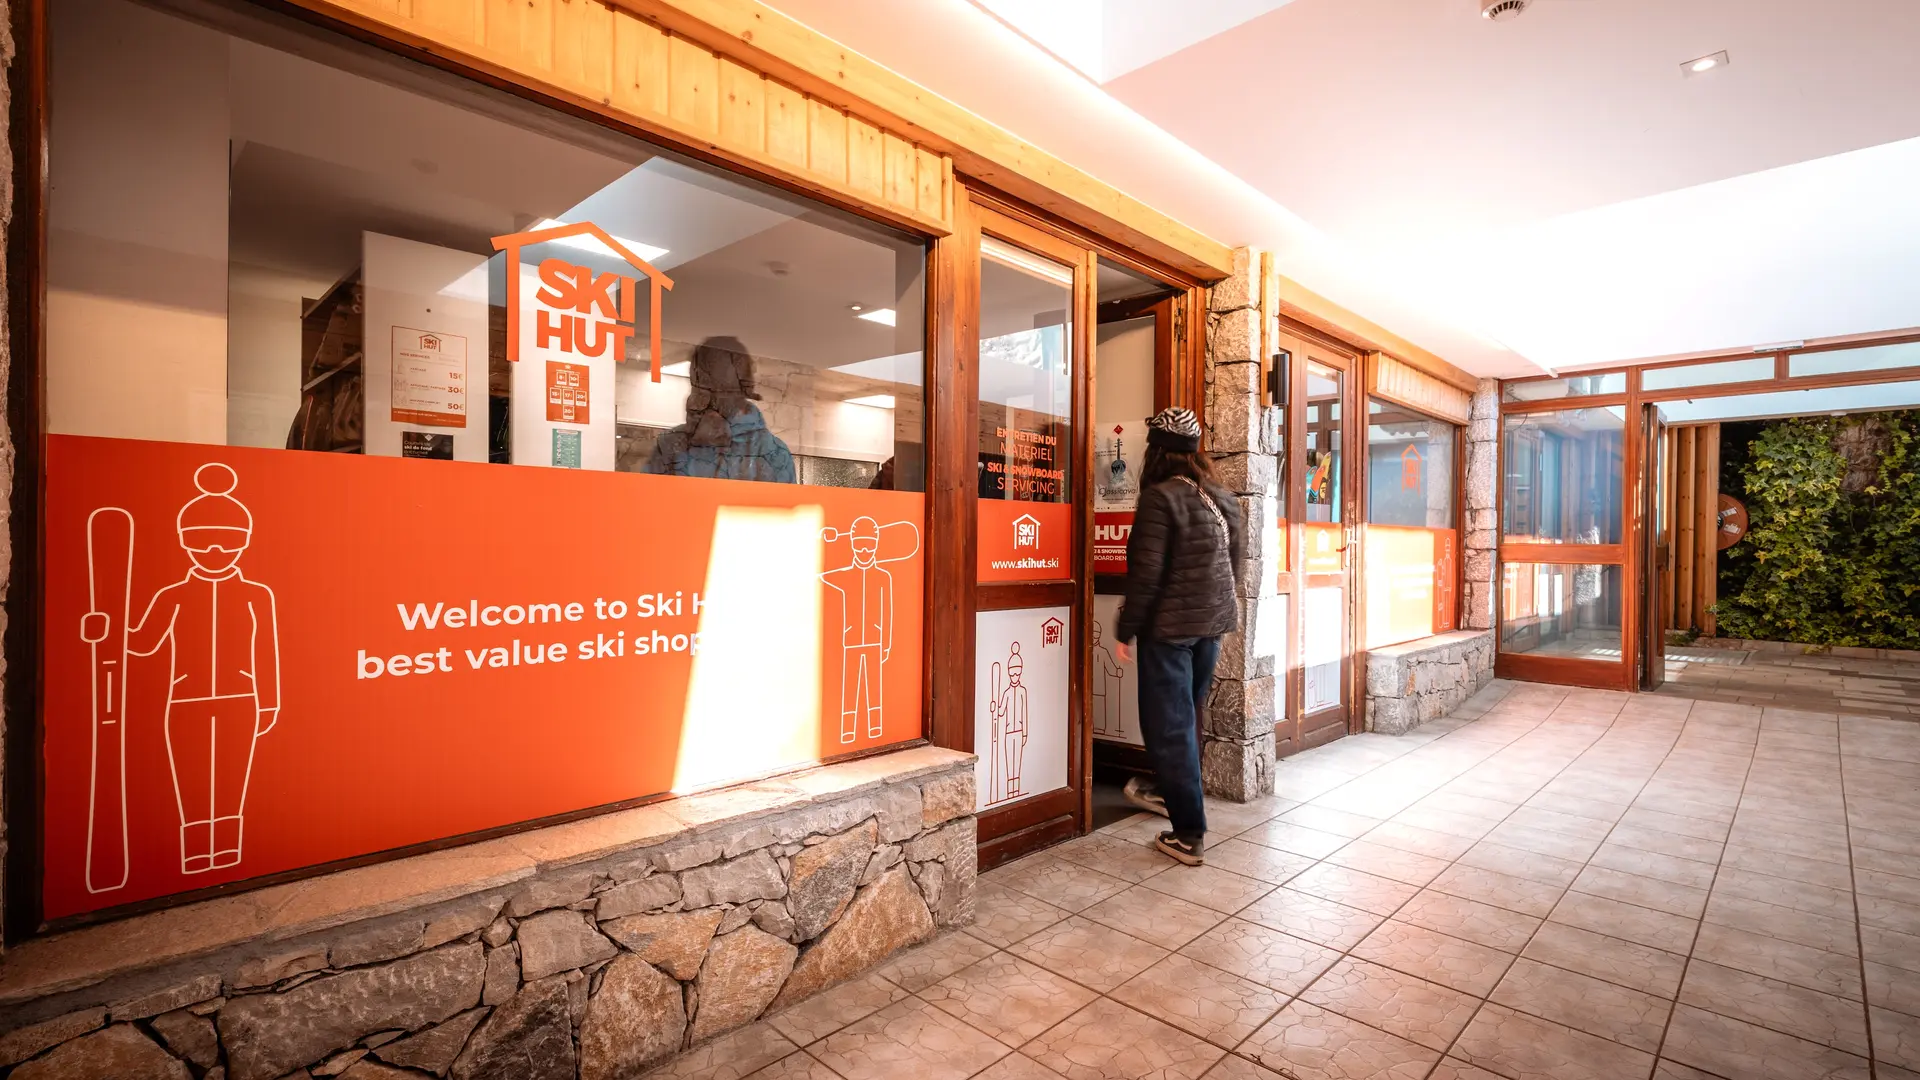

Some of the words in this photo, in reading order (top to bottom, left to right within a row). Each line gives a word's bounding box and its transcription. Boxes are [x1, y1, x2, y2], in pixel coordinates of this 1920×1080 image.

[536, 258, 636, 323] SKI
[536, 310, 635, 362] HUT
[448, 386, 464, 394] 30€
[996, 426, 1044, 445] ENTRETIEN
[1045, 436, 1057, 446] DU
[1000, 442, 1052, 461] MATERIEL
[986, 462, 1002, 473] SKI
[1003, 465, 1008, 474] &
[1010, 465, 1063, 480] SNOWBOARD
[997, 477, 1055, 495] SERVICING
[1018, 524, 1035, 536] SKI
[1018, 535, 1034, 546] HUT
[992, 557, 1059, 569] www.skihut.ski
[397, 600, 584, 631] Welcome
[594, 597, 627, 620] to
[638, 591, 682, 618] Ski
[1046, 625, 1059, 636] SKI
[1046, 635, 1058, 645] HUT
[357, 646, 453, 680] best
[465, 639, 568, 670] value
[578, 631, 624, 660] ski
